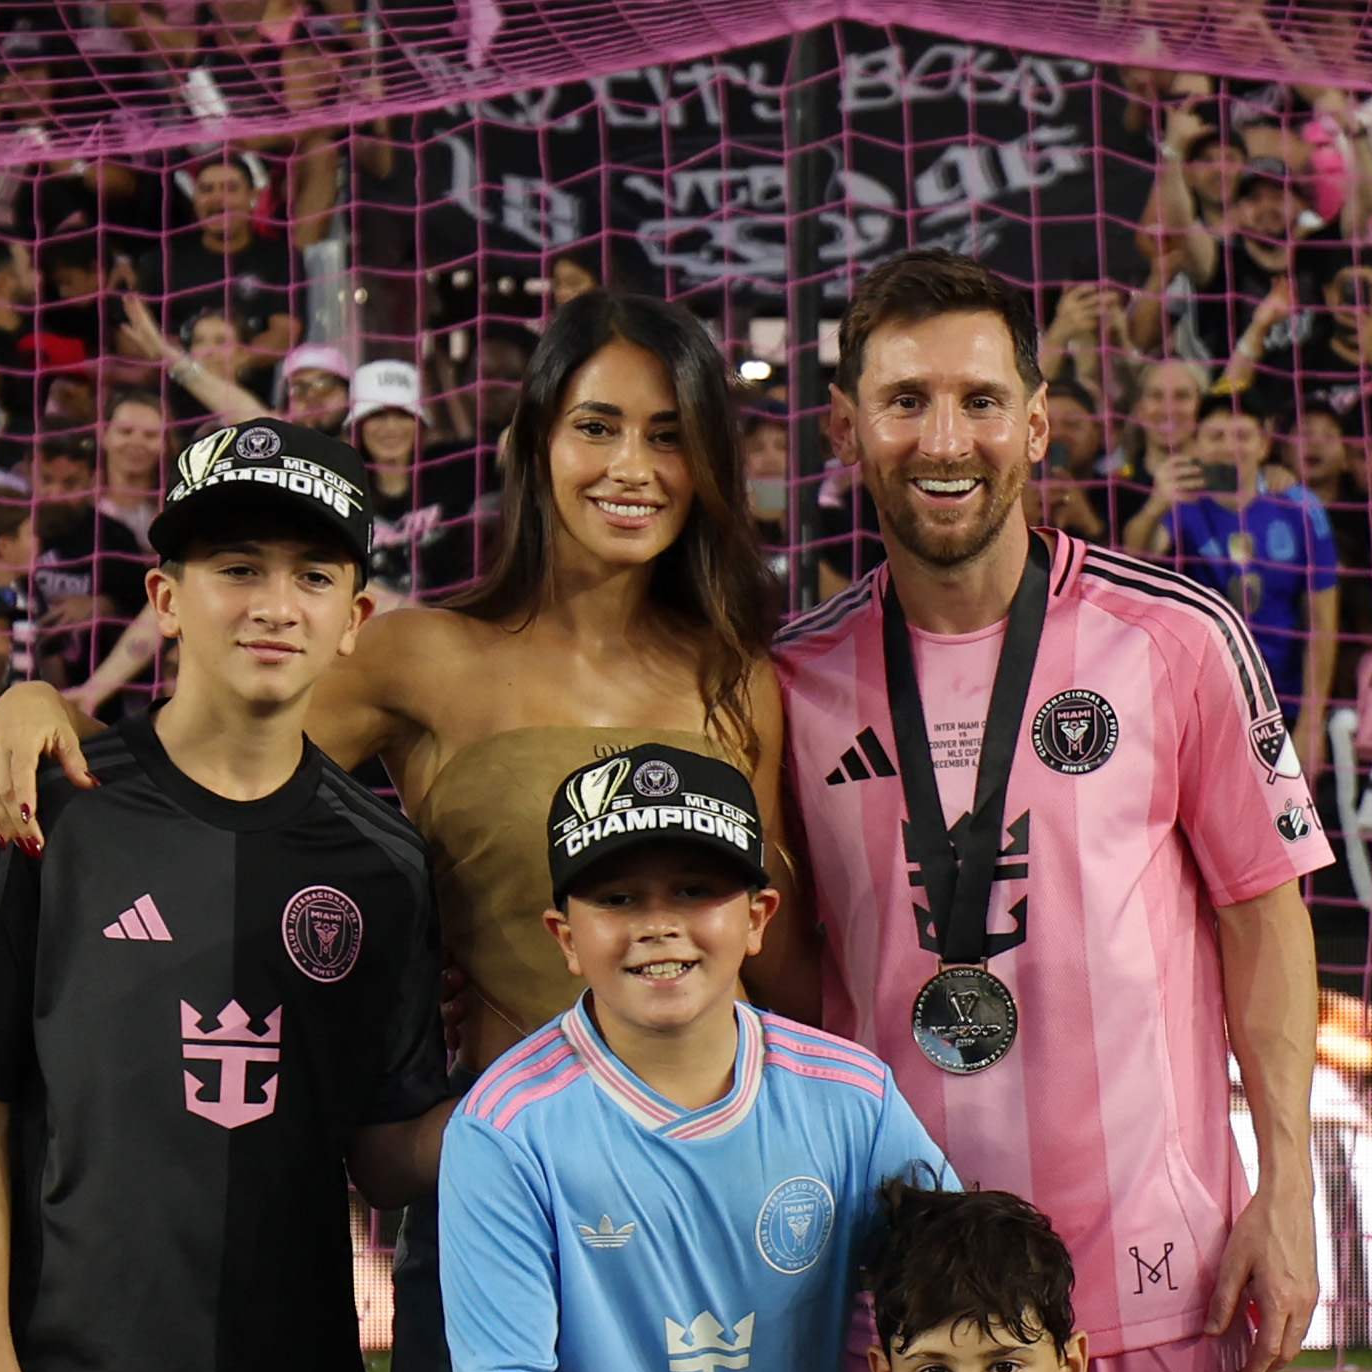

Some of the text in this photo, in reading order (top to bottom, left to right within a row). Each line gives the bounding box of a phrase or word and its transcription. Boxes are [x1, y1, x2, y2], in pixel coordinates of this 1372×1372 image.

[283, 459, 352, 495] MLS CUP
[1033, 690, 1101, 730] INTERNACIONAL
[1057, 709, 1091, 720] MIAMI
[1101, 703, 1112, 717] DE
[934, 722, 955, 732] INTER
[958, 720, 979, 730] MIAMI
[1254, 721, 1284, 743] MLS
[948, 748, 979, 758] MLS CUP
[1033, 733, 1047, 757] CLUB
[1061, 763, 1091, 773] MMXX
[612, 798, 632, 810] 25
[684, 795, 748, 825] MLS CUP
[565, 807, 749, 858] CHAMPIONS
[288, 891, 349, 924] INTERNACIONAL
[310, 910, 342, 922] MIAMI
[288, 928, 300, 954] CLUB
[784, 1203, 815, 1214] MIAMI
